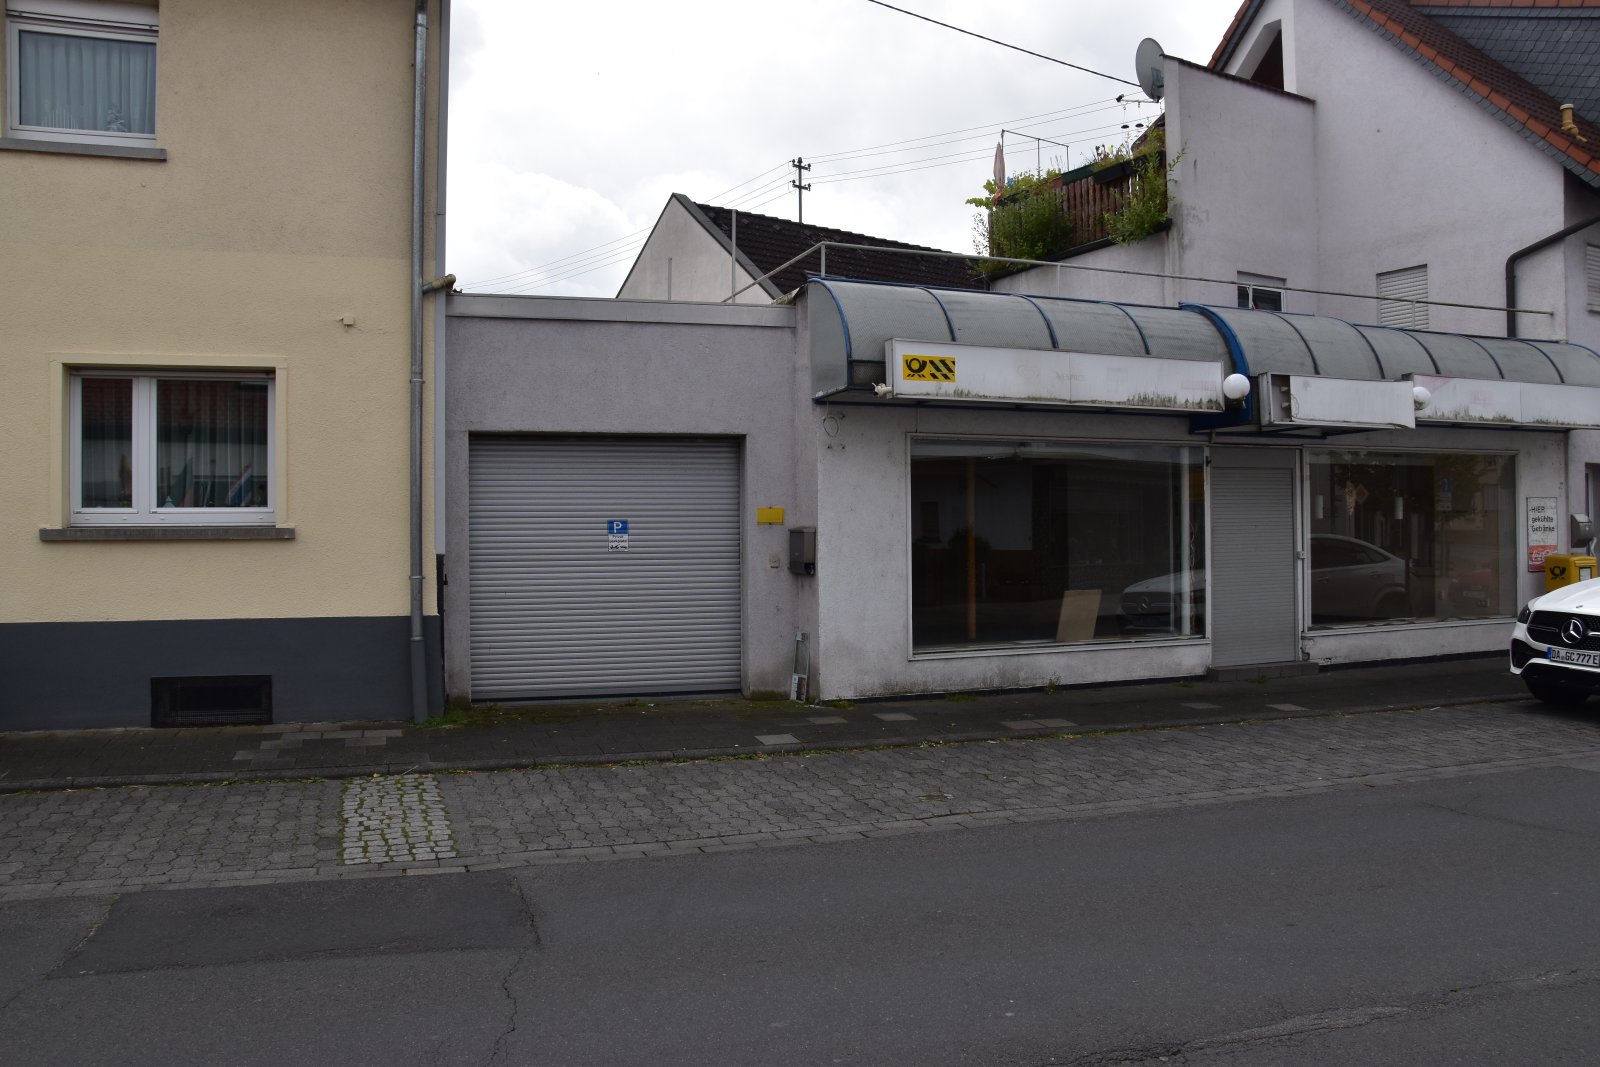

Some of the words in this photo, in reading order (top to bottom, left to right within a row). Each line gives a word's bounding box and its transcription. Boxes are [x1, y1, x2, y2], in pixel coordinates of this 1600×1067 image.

[1531, 515, 1554, 524] gekühlte
[613, 521, 622, 533] P
[1552, 649, 1561, 660] DA
[1565, 651, 1575, 662] GC
